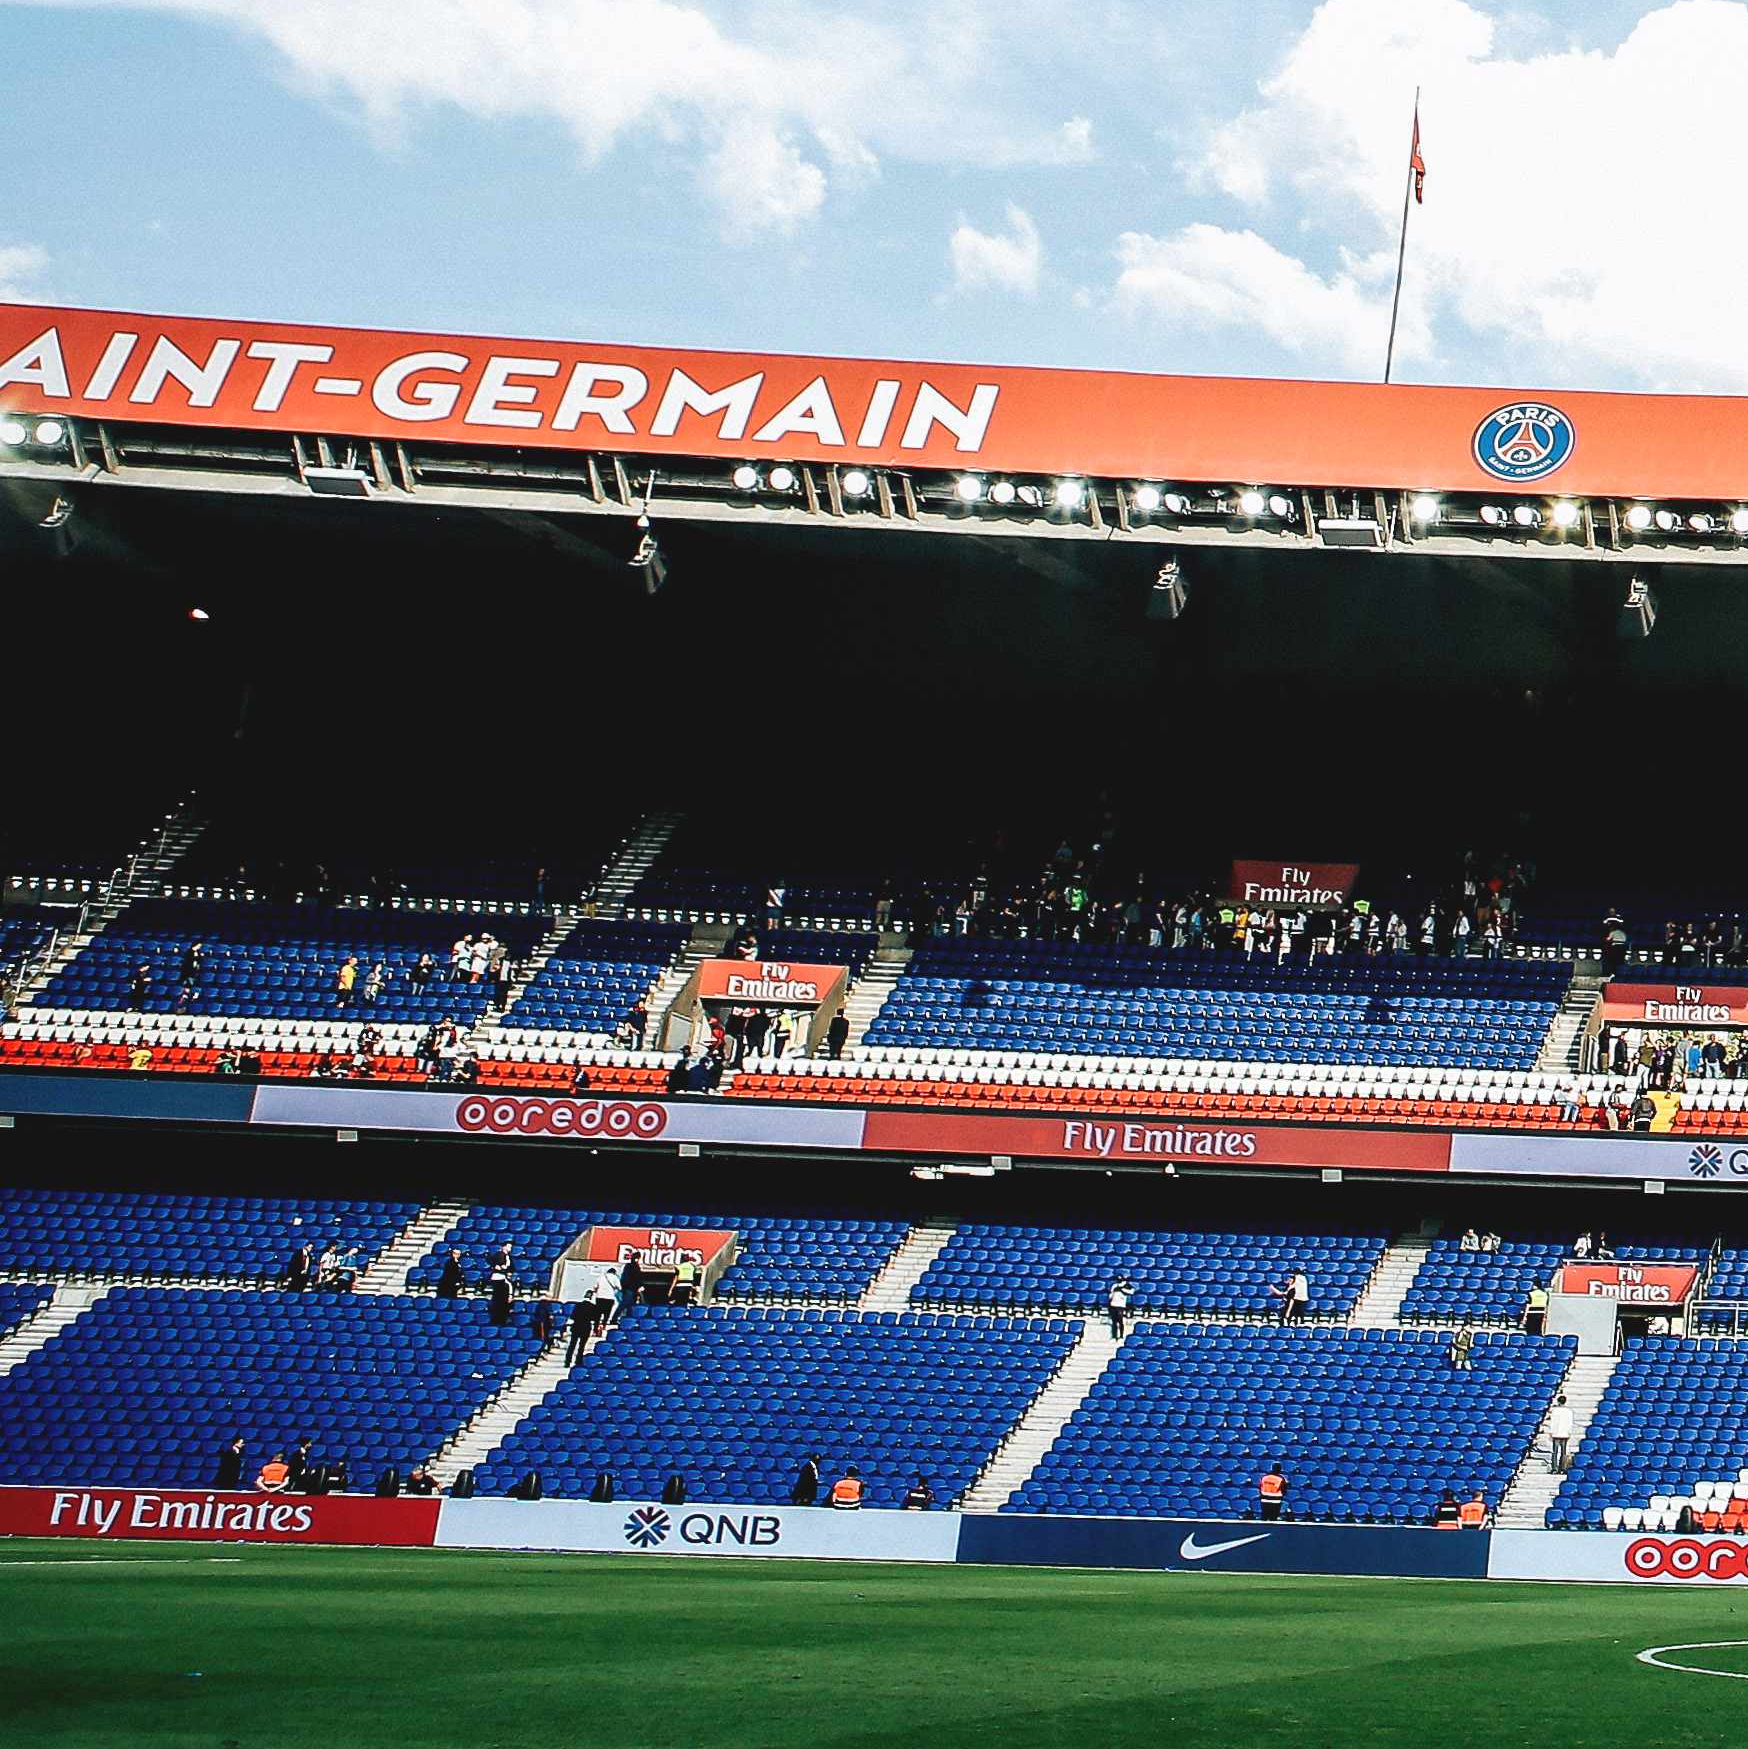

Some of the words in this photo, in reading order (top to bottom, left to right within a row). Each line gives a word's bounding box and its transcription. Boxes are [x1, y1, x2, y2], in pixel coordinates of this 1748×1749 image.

[0, 326, 1000, 452] AINT-GERMAIN
[1495, 407, 1560, 428] PARIS
[1282, 867, 1309, 887] Fly
[1245, 884, 1342, 904] Emirates
[763, 963, 790, 981] Fly
[729, 976, 818, 1000] Emirates
[1677, 986, 1702, 1003] Fly
[1646, 999, 1731, 1024] Emirates
[462, 1101, 661, 1132] ooredoo
[1063, 1120, 1116, 1156] Fly
[1123, 1125, 1257, 1158] Emirates
[650, 1231, 676, 1249] Fly
[1619, 1267, 1643, 1284] Fly
[1589, 1280, 1670, 1301] Emirates
[50, 1492, 120, 1534] Fly
[130, 1494, 312, 1533] Emirates
[680, 1514, 781, 1546] QNB
